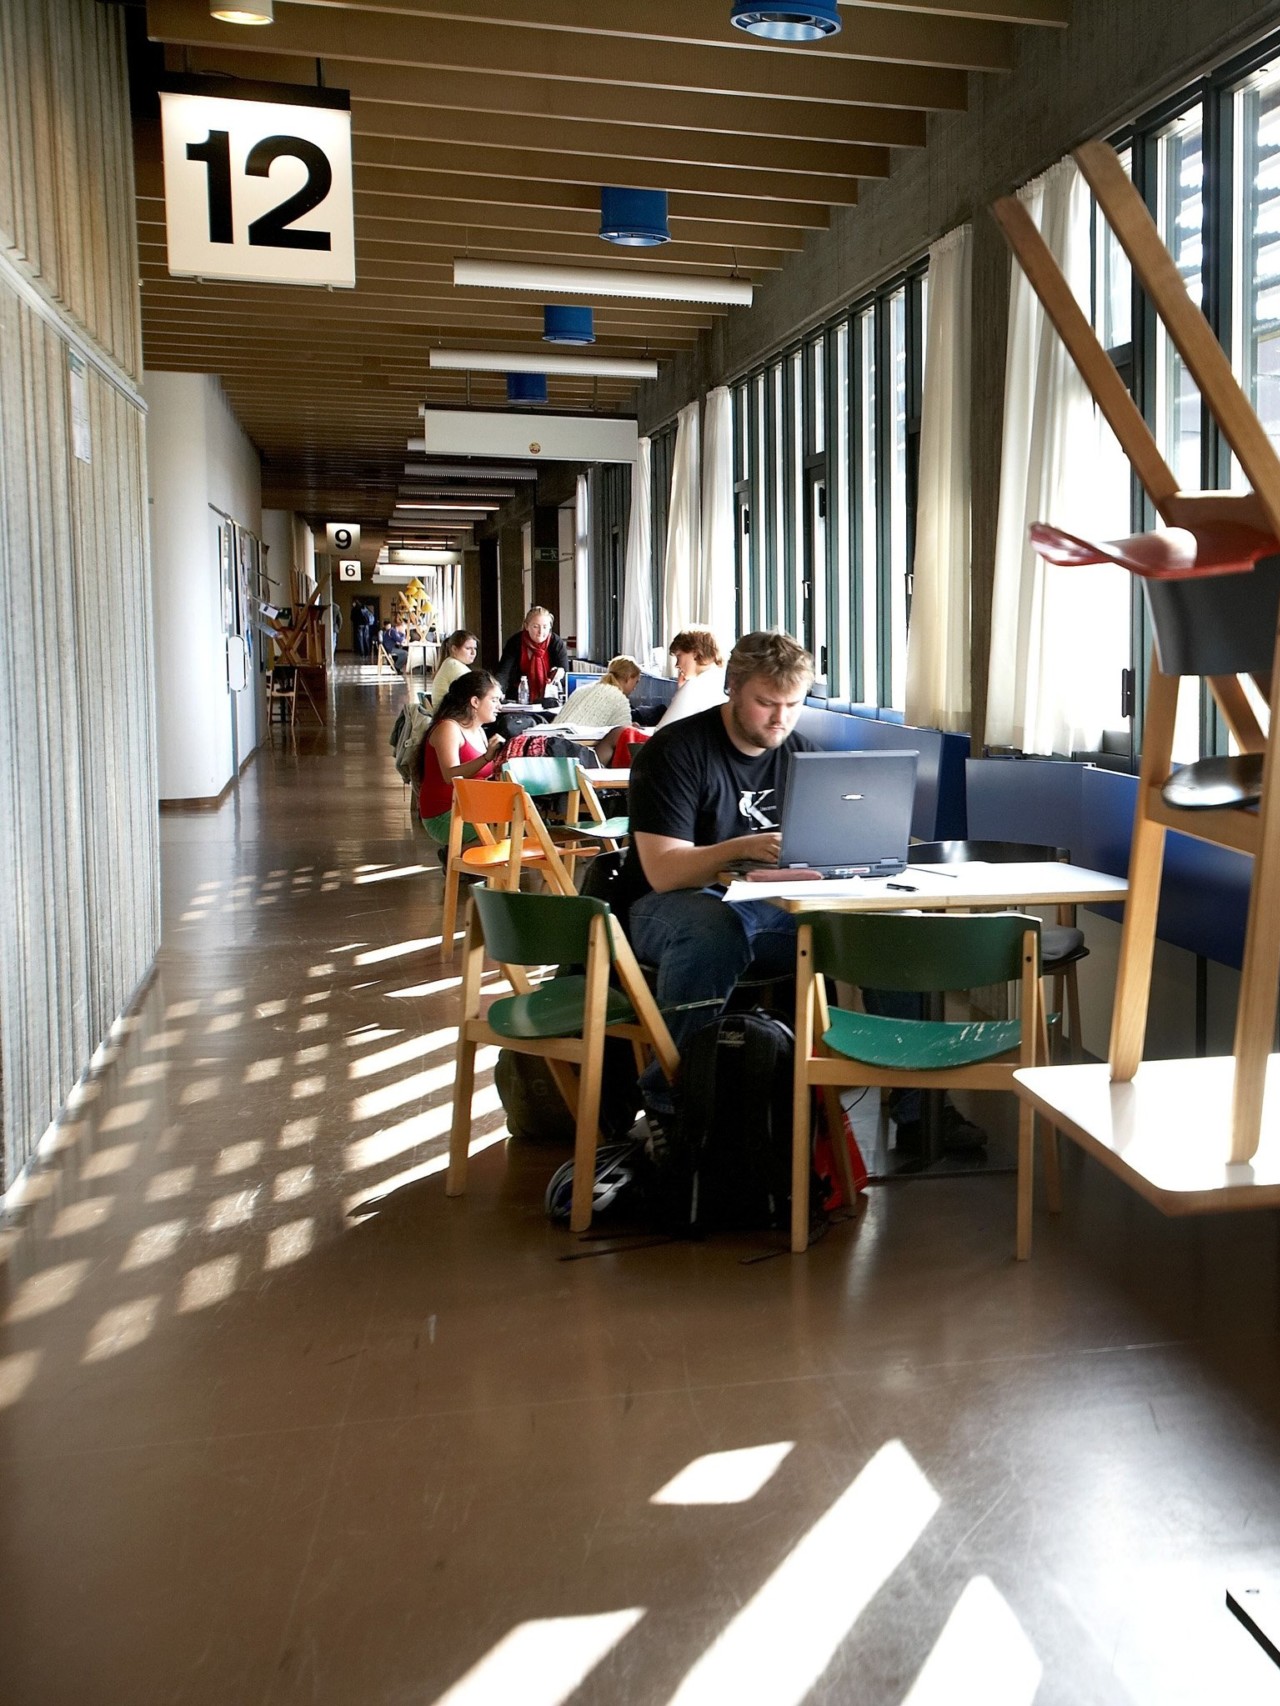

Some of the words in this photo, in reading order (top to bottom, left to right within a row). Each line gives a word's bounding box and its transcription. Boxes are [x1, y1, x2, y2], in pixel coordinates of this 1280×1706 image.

[186, 129, 333, 252] 12
[335, 529, 352, 550] 9
[345, 564, 356, 577] 6
